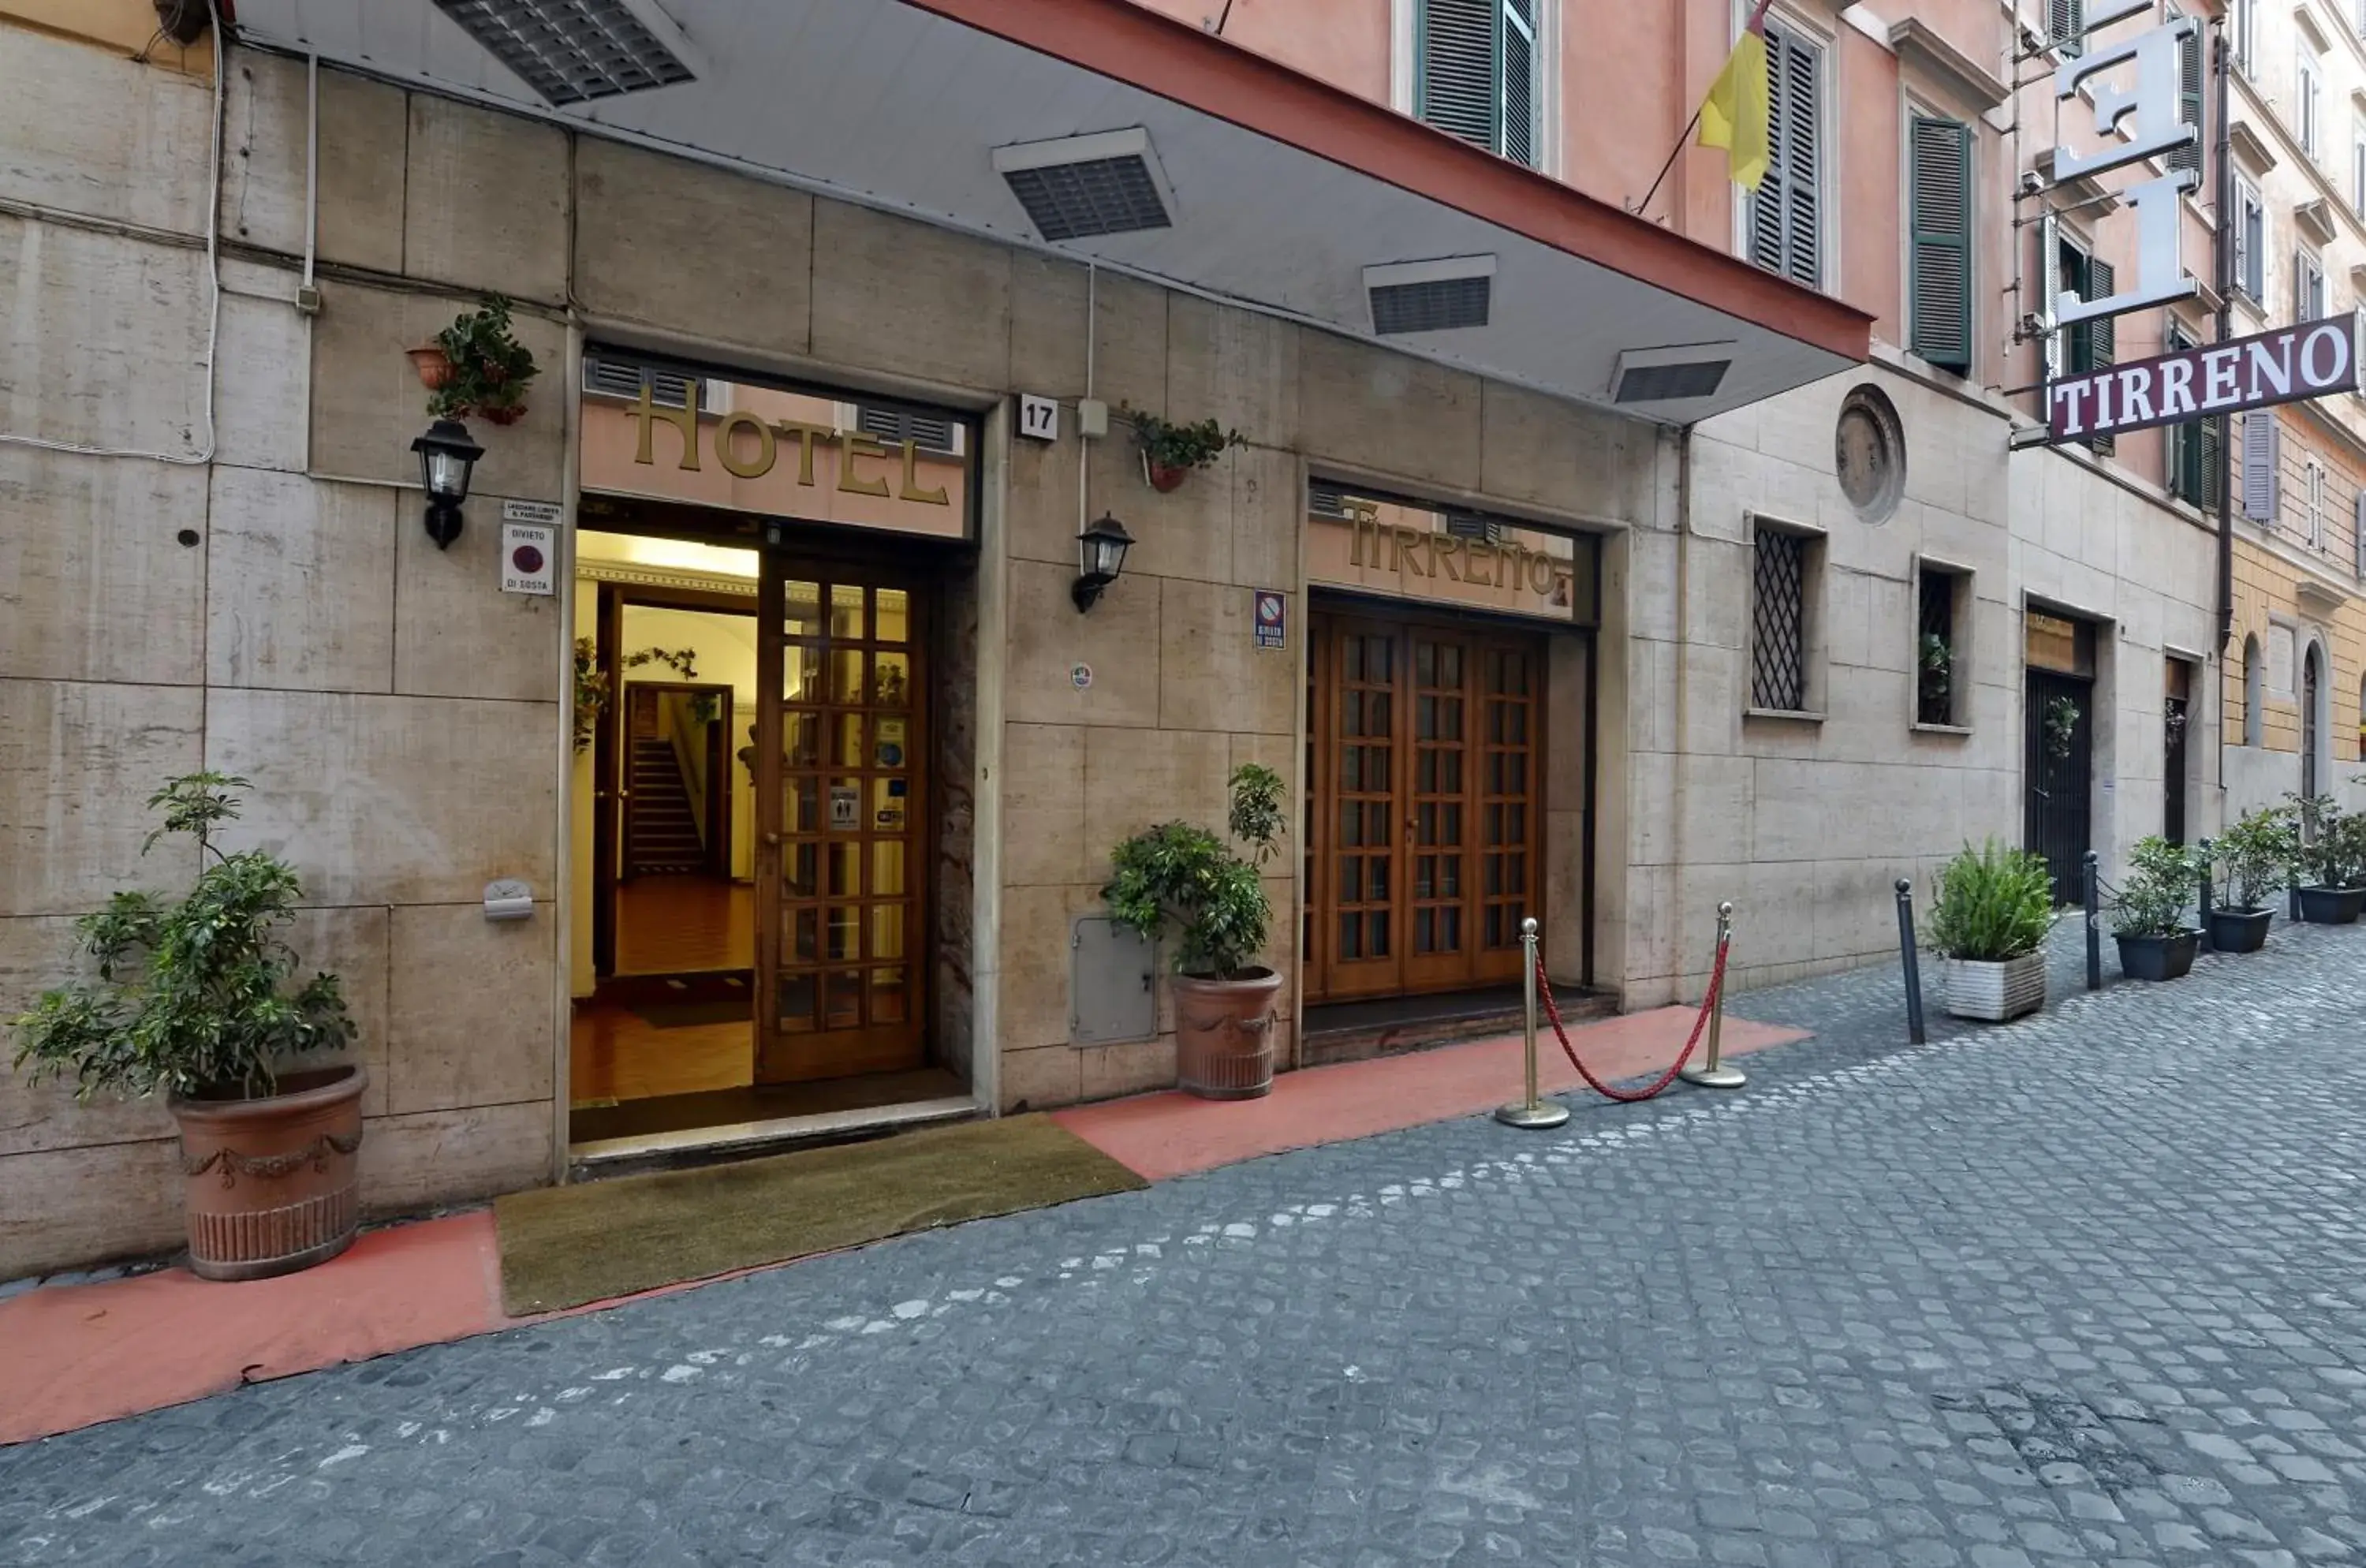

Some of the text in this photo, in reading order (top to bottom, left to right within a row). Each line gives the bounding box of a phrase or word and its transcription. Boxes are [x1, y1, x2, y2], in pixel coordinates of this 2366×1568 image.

[2055, 324, 2348, 436] TIRRENO
[625, 379, 949, 506] HOTEL
[1027, 403, 1053, 430] 17
[513, 529, 544, 540] DIVIETO
[1339, 495, 1556, 595] TIRRENO
[507, 578, 547, 590] DI SOSTA
